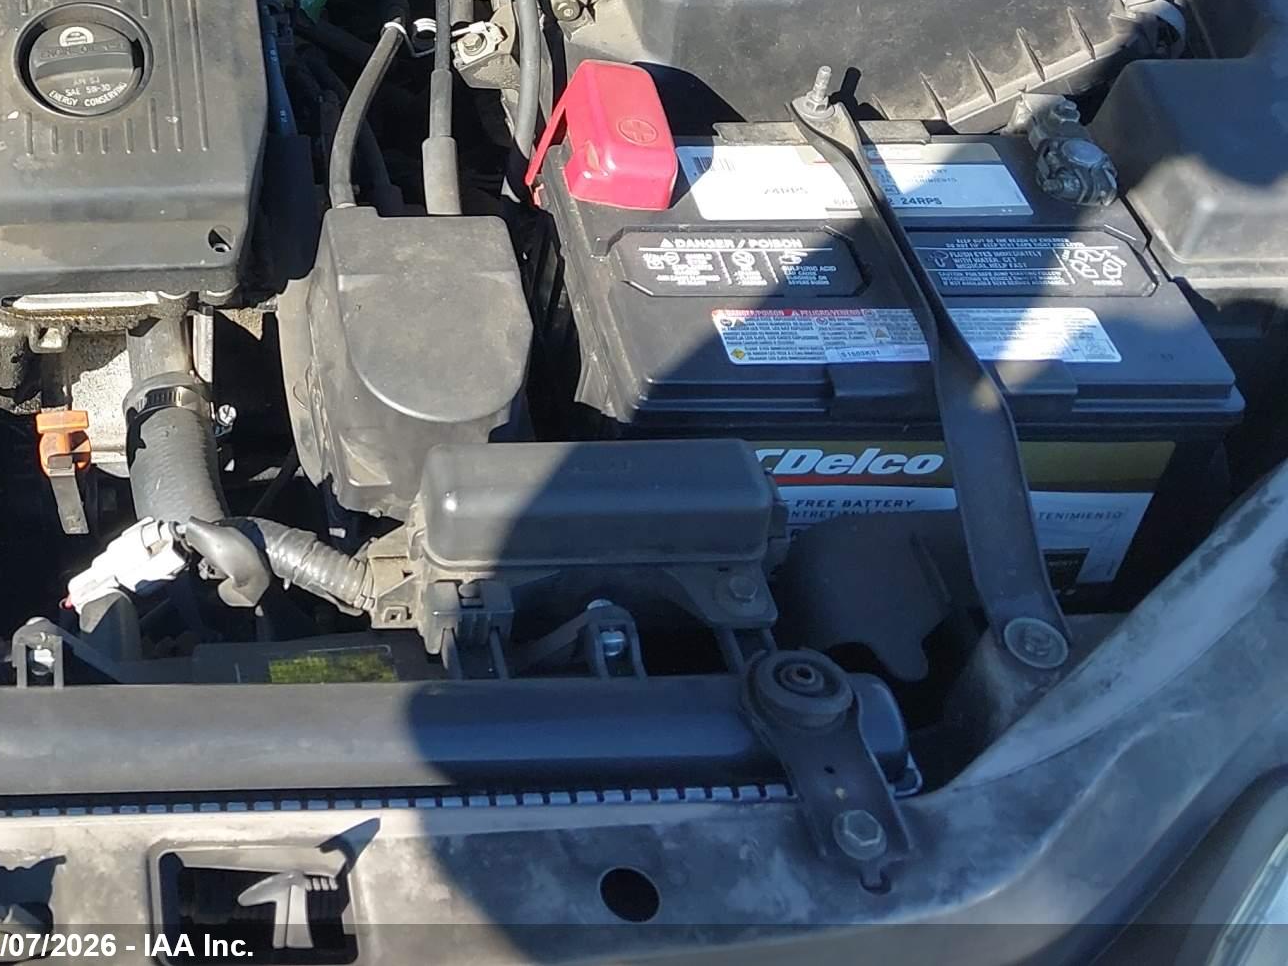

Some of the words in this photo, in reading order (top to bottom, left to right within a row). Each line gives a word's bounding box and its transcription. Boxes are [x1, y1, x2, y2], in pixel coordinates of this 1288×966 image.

[48, 90, 79, 107] ENERGY
[901, 197, 943, 206] 24RPS
[674, 238, 735, 249] DANGER
[749, 238, 804, 249] POISON
[794, 499, 838, 509] FREE
[841, 499, 916, 510] BATTERY
